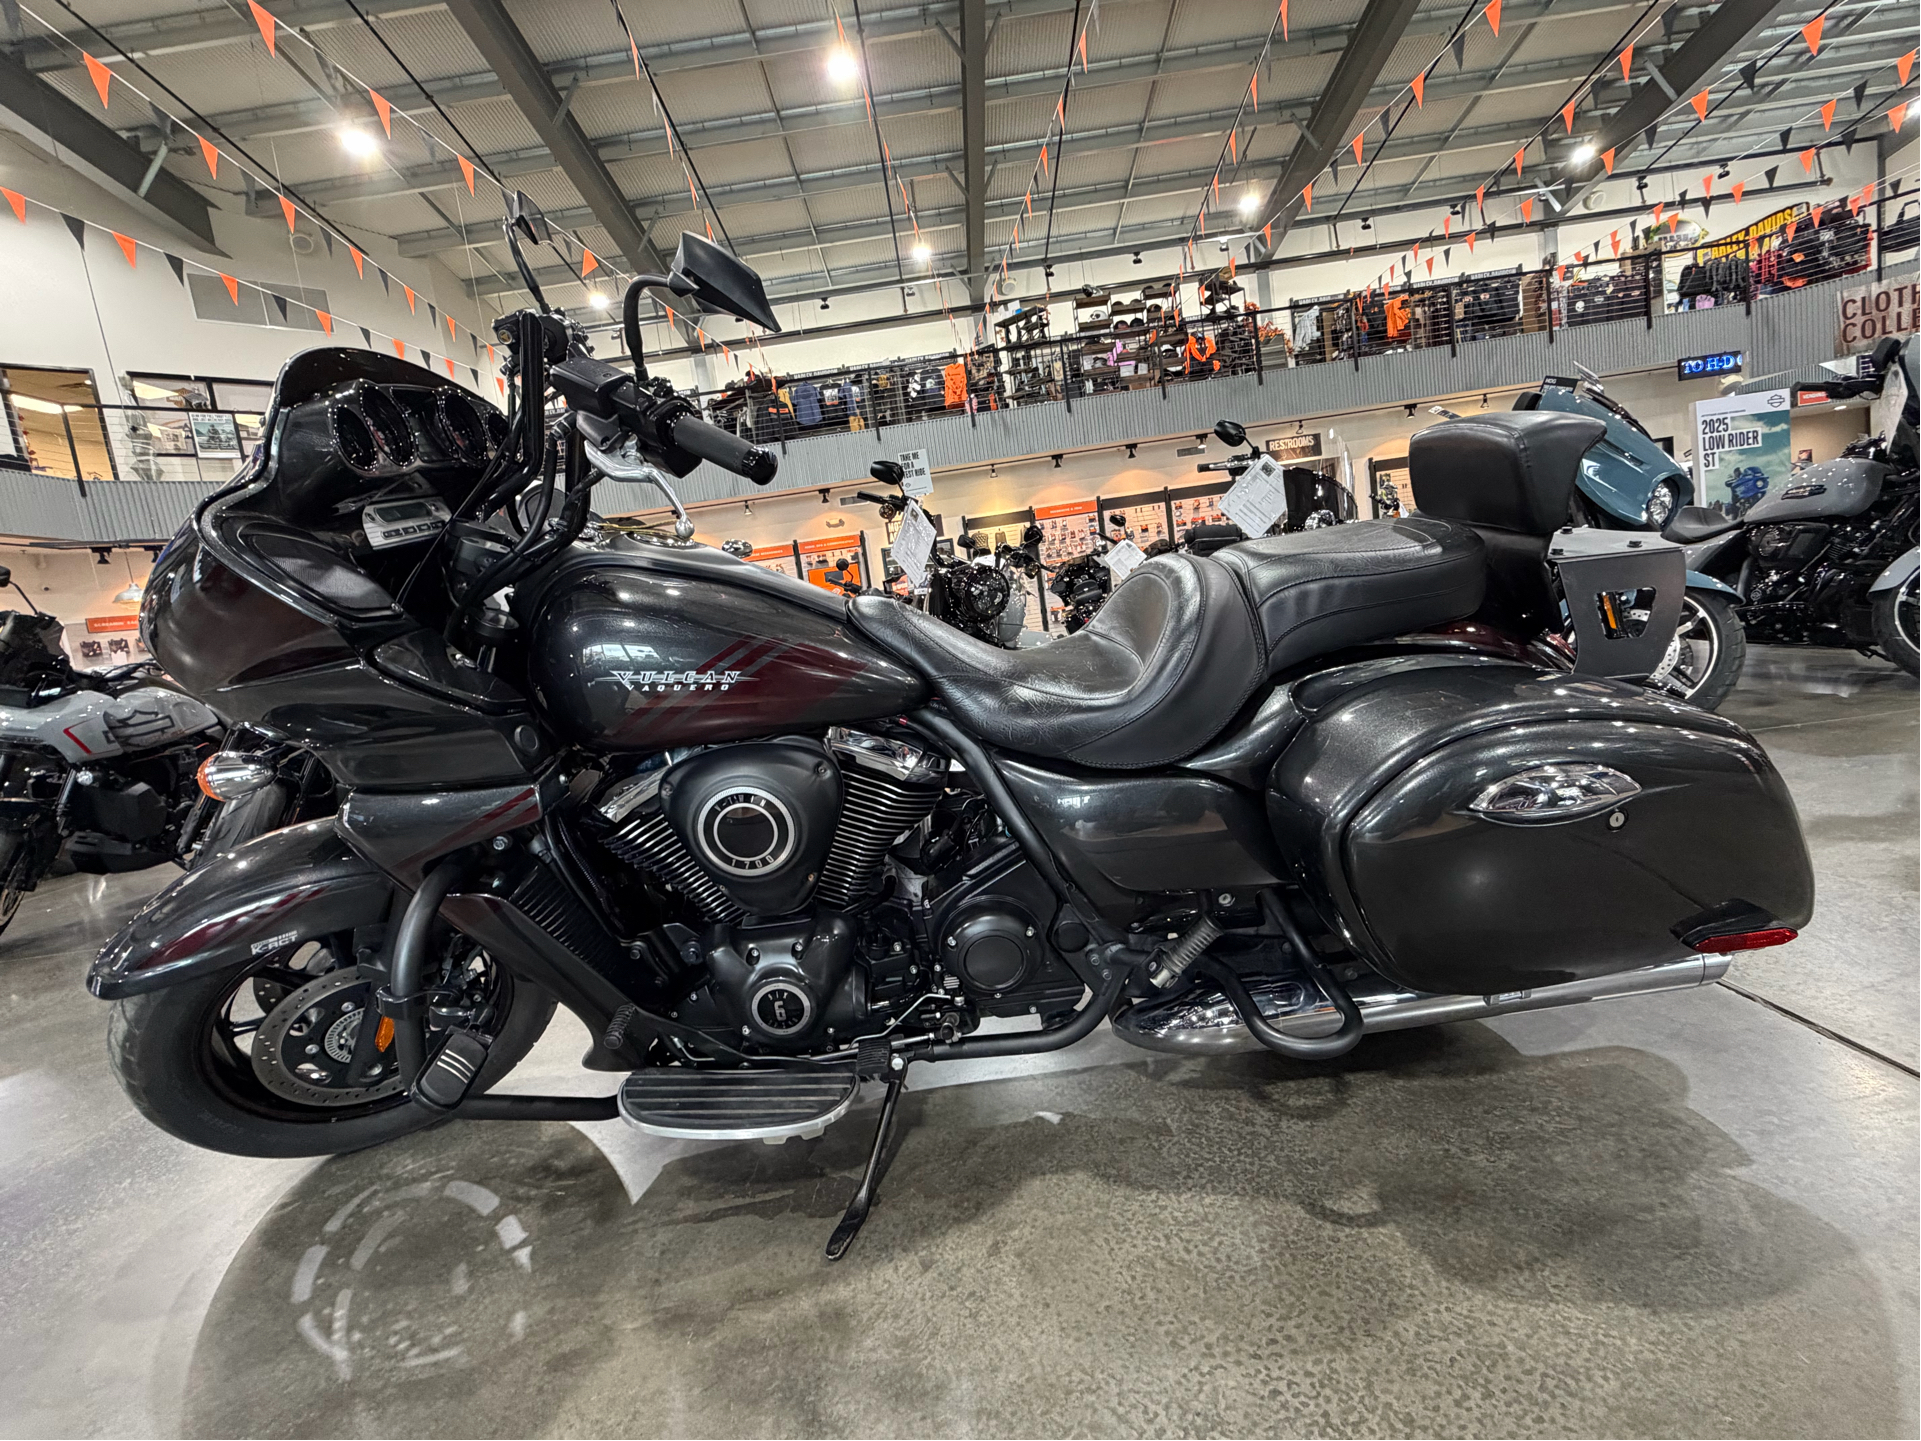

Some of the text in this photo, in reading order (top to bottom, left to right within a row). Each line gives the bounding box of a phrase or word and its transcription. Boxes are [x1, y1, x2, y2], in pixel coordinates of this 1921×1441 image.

[1702, 417, 1729, 435] 2025
[1269, 435, 1315, 451] RESTROOMS
[1702, 430, 1760, 451] LOW RIDER
[899, 453, 911, 462] TAKE
[1703, 452, 1717, 468] ST
[609, 671, 741, 684] VULCAN
[625, 684, 729, 692] VAQUERO
[714, 794, 767, 812] V-TWIN
[731, 854, 775, 870] 1700
[774, 1001, 787, 1021] 6
